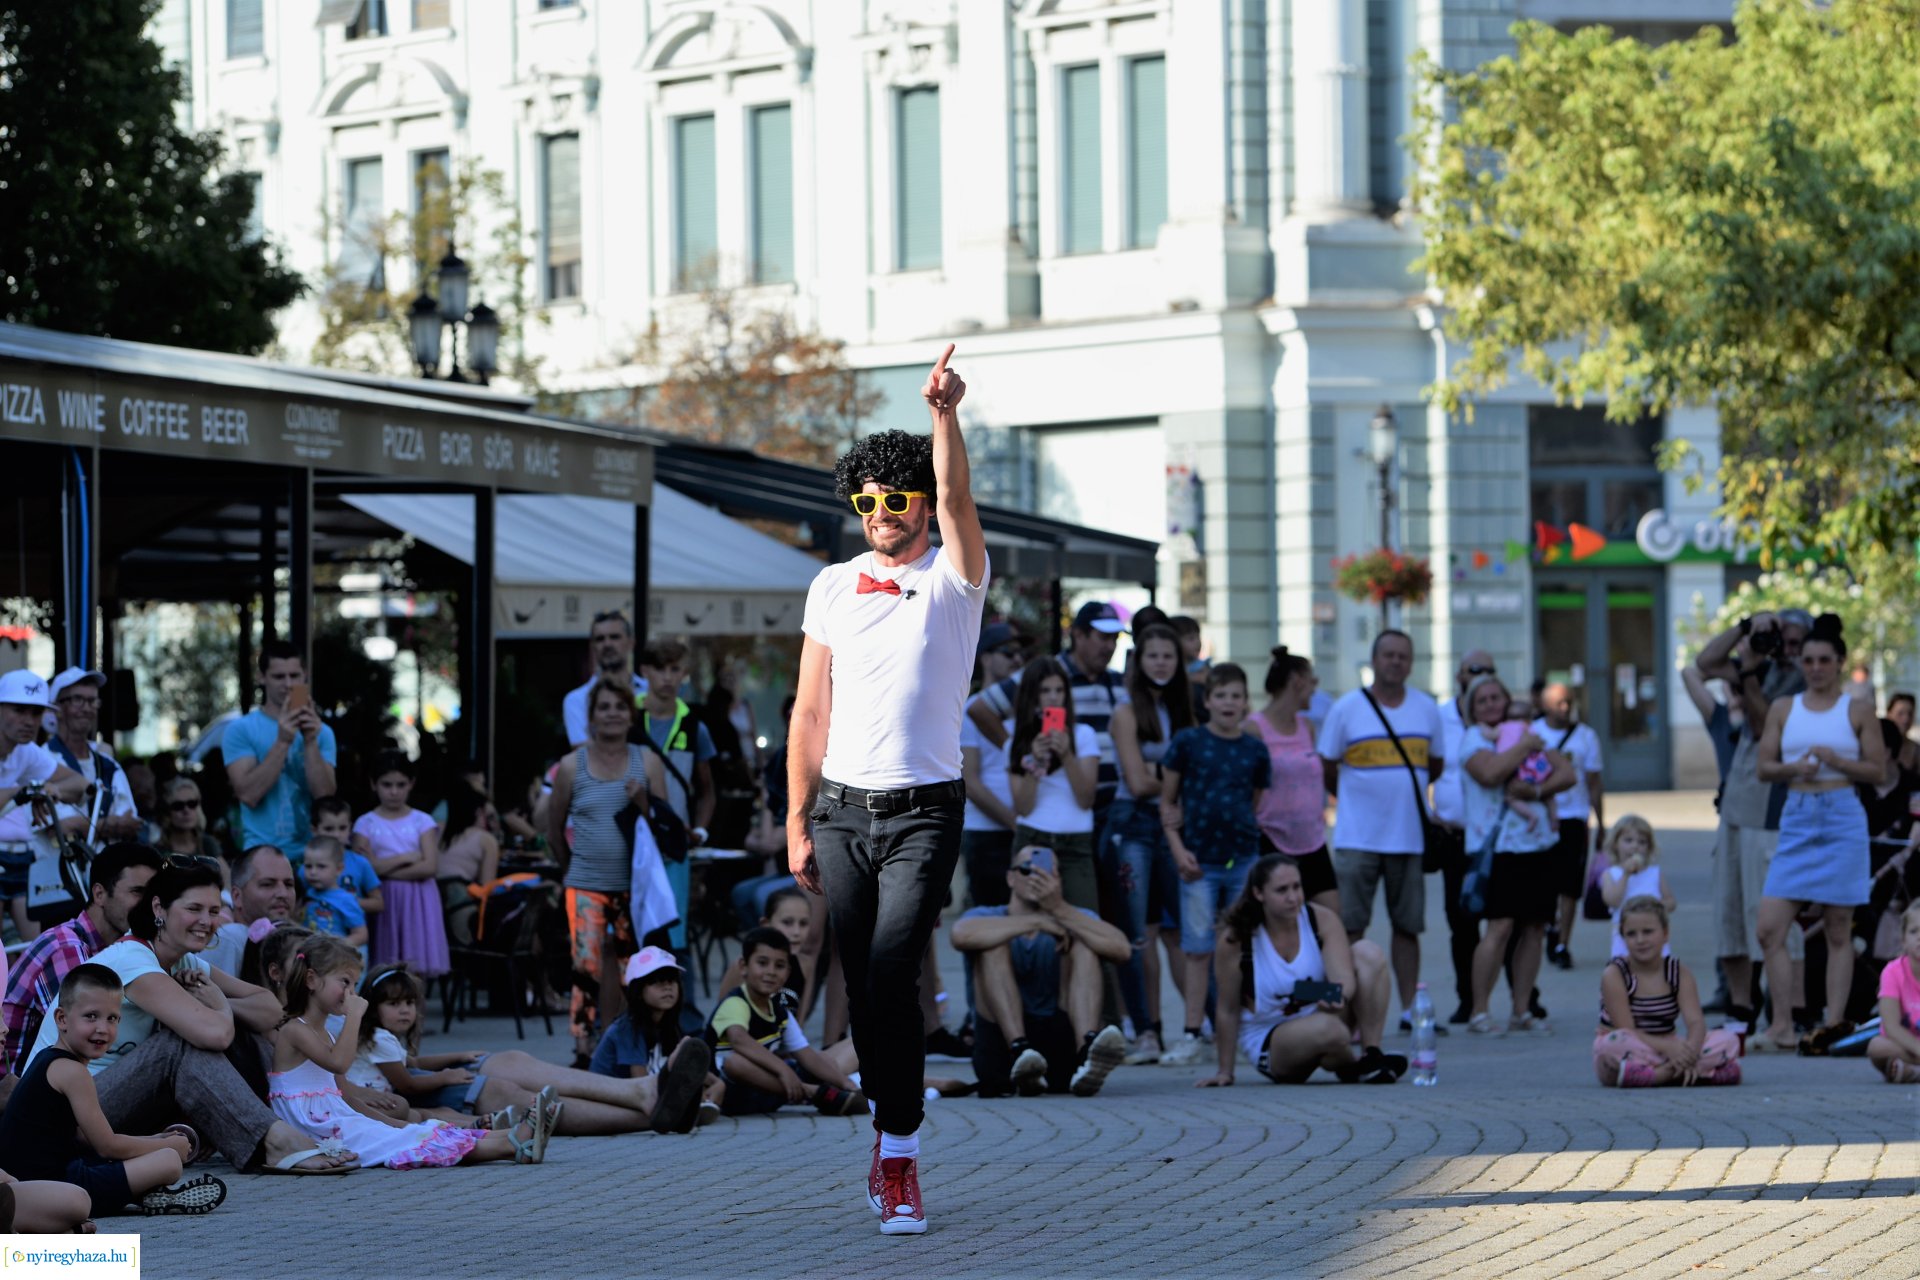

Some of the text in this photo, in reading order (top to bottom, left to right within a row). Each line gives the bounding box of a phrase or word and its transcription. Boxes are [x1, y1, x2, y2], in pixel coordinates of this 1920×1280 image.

[57, 388, 107, 433] WINE
[119, 397, 191, 441] COFFEE
[201, 404, 249, 446] BEER
[382, 423, 426, 463] PIZZA
[439, 430, 473, 467] BOR
